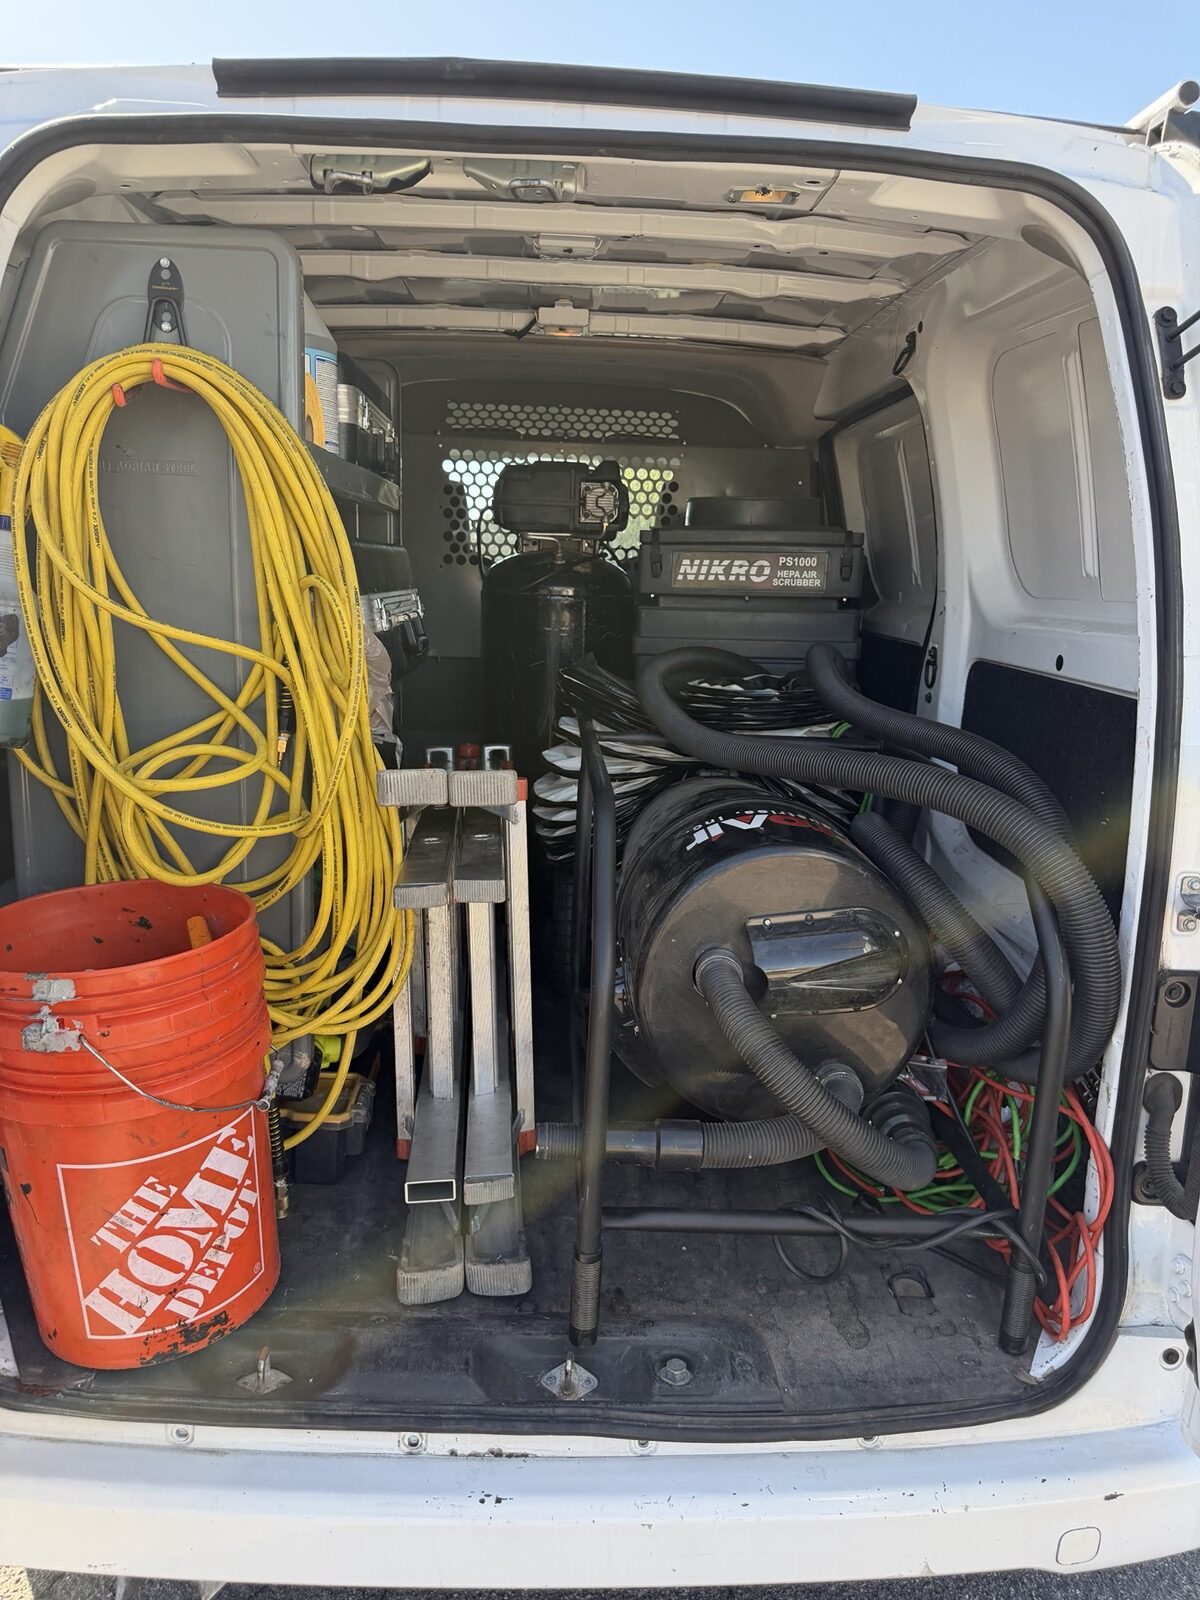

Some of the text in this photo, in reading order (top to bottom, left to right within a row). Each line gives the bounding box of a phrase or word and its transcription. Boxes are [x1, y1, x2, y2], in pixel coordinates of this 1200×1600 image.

[73, 383, 87, 403] HUSKY
[677, 559, 771, 583] NIKRO
[779, 556, 818, 567] PS1000
[772, 578, 821, 588] SCRUBBER
[777, 569, 817, 579] HEPA AIR
[57, 707, 70, 725] HUSKY
[90, 1176, 178, 1253] THE
[84, 1127, 254, 1335] HOME
[164, 1179, 258, 1319] DEPOT
